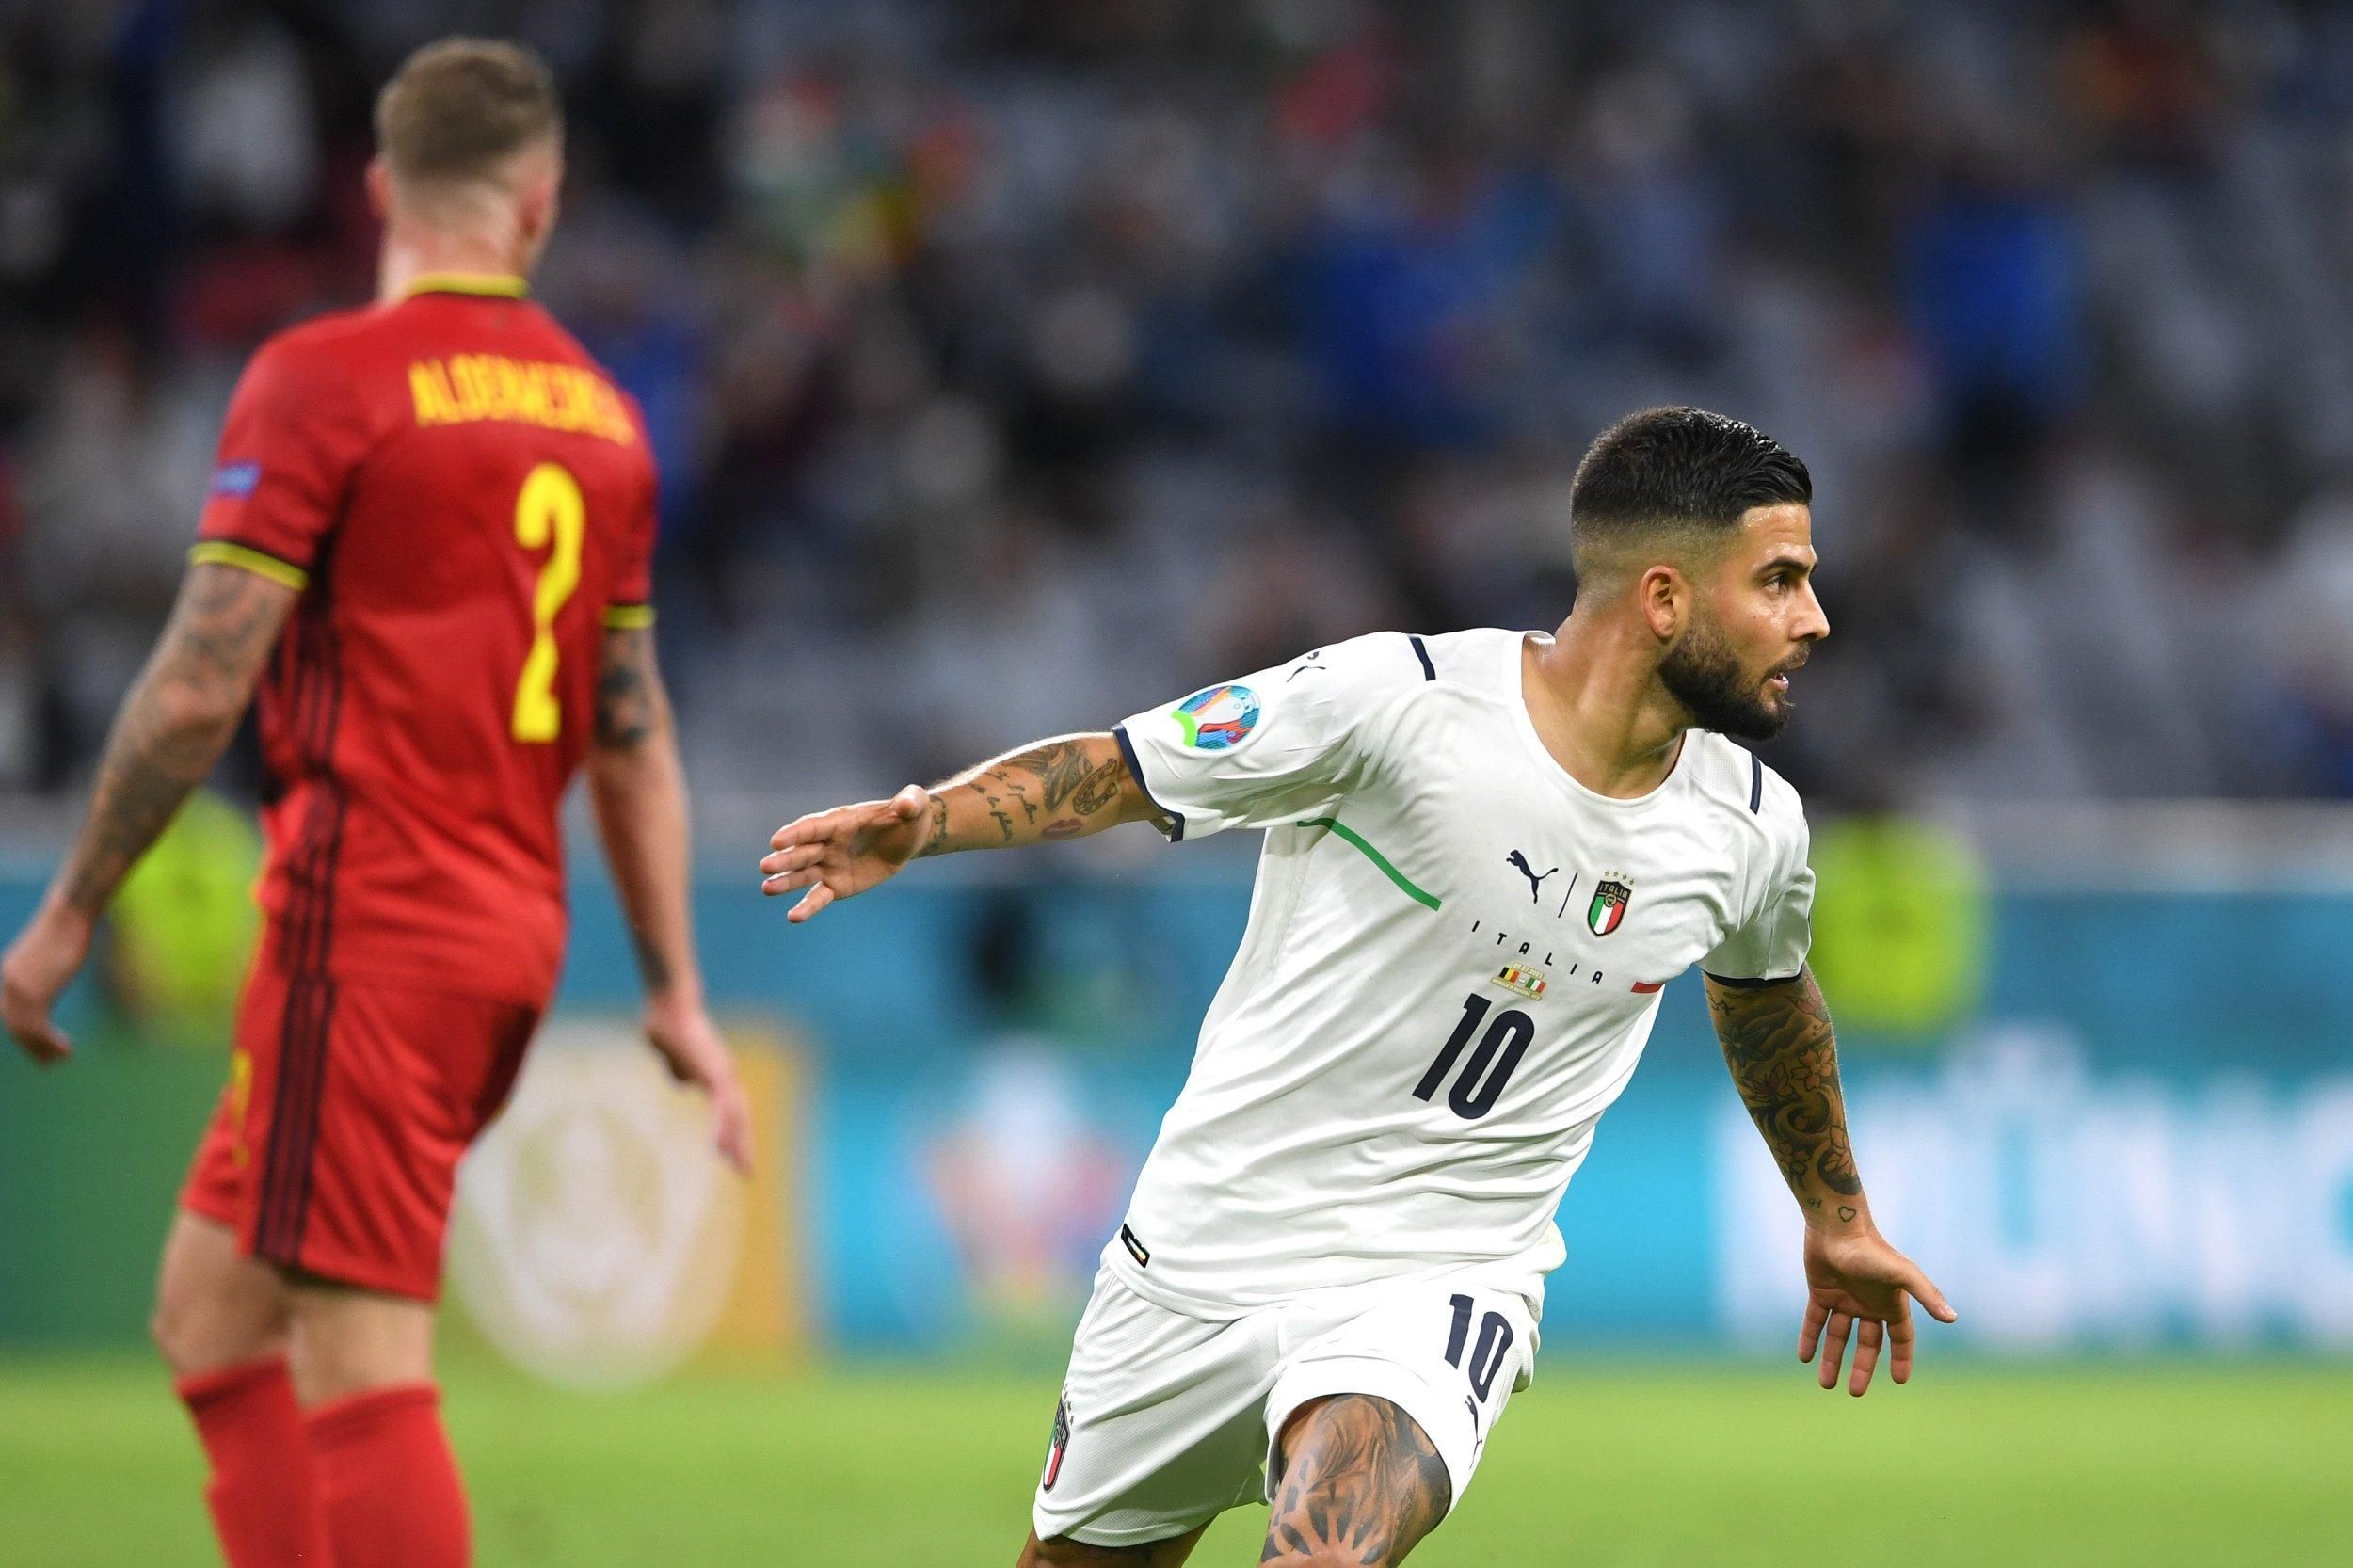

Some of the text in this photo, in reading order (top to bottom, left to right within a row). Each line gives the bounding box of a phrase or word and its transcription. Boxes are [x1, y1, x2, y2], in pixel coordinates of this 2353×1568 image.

[513, 461, 585, 743] 2
[1597, 883, 1629, 900] ITALIA
[1471, 920, 1604, 984] ITALIA
[1412, 993, 1535, 1120] 10
[1444, 1293, 1514, 1403] 10
